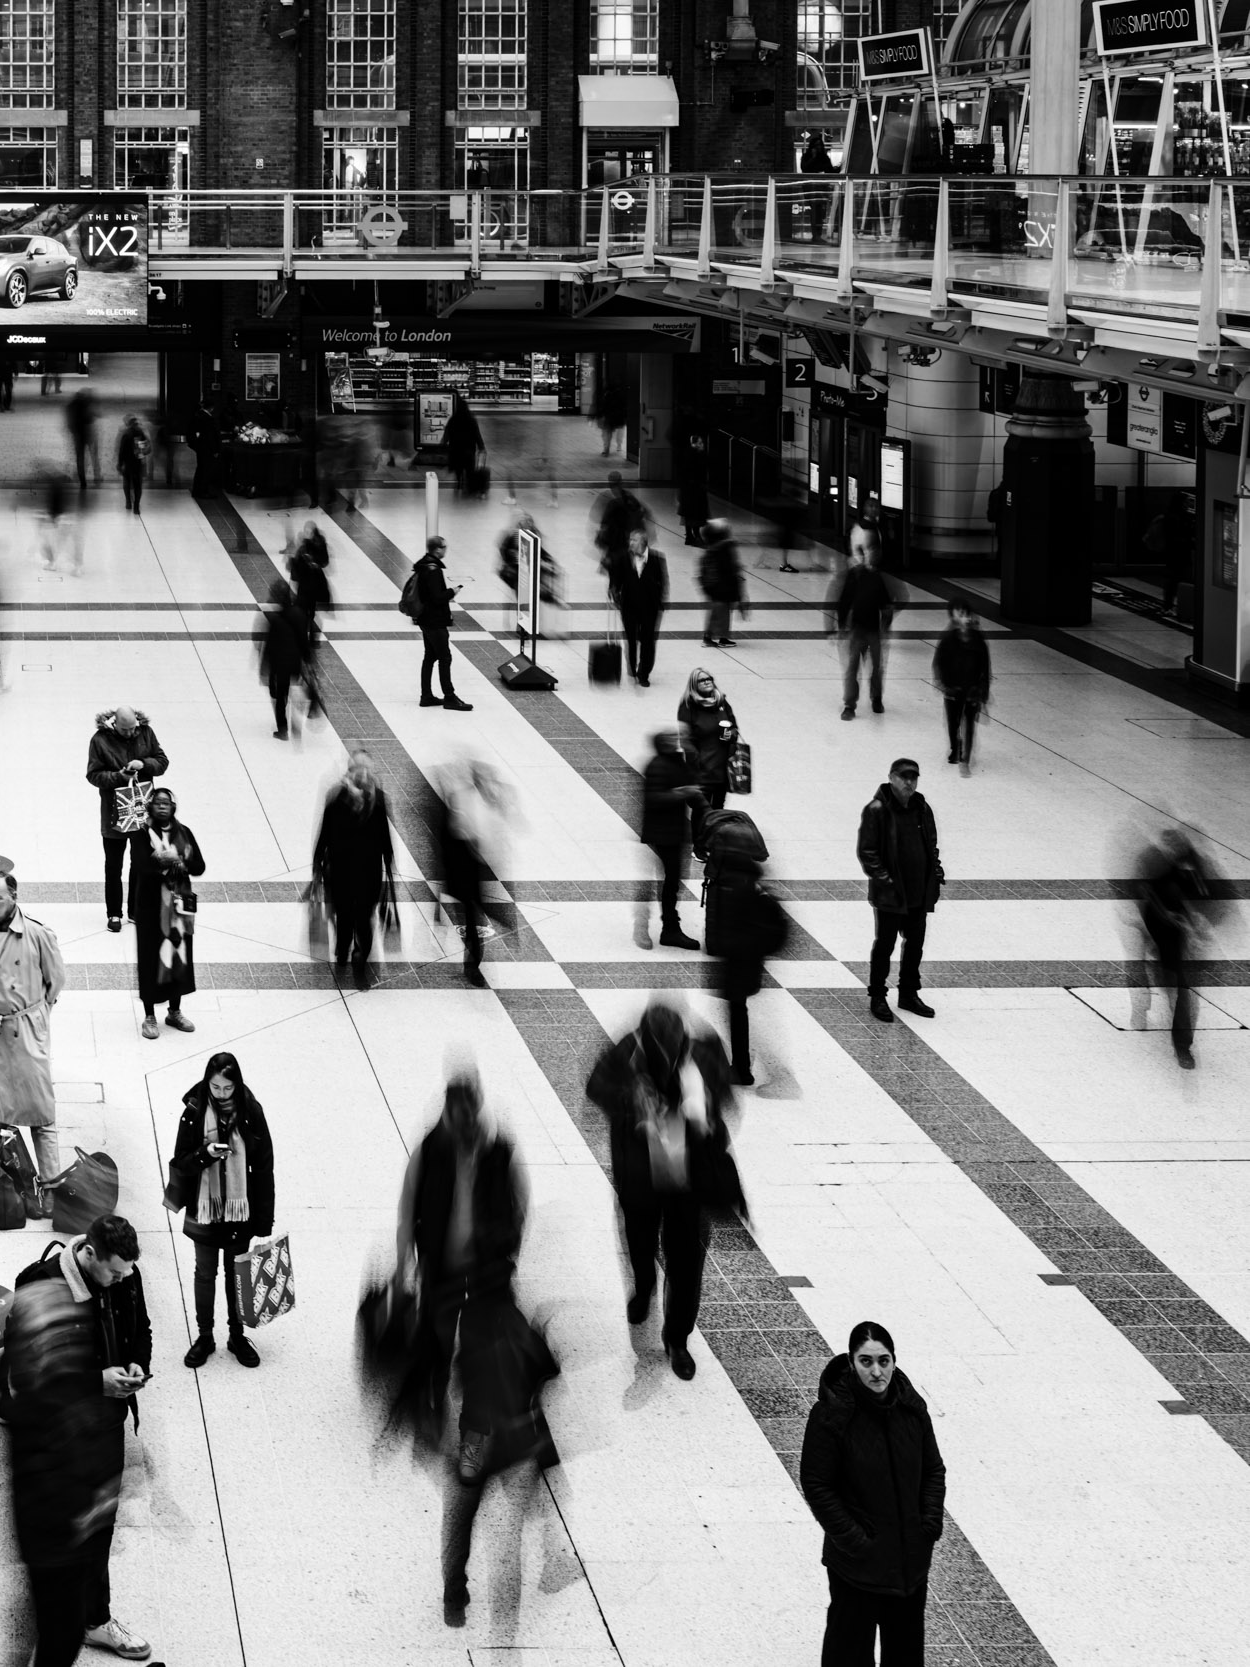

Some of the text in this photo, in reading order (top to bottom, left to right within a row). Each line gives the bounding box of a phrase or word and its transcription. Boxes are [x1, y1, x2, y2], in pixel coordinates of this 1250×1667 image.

[1107, 16, 1128, 36] M&S
[1159, 8, 1190, 30] FOOD
[899, 44, 918, 61] FOOD
[87, 213, 138, 221] THE NEW
[88, 225, 139, 257] iX2
[86, 308, 138, 316] 100% ELECTRIC
[6, 334, 47, 344] JCDecaux
[321, 328, 452, 343] Welcome to London
[731, 347, 739, 364] 1
[794, 363, 807, 381] 2
